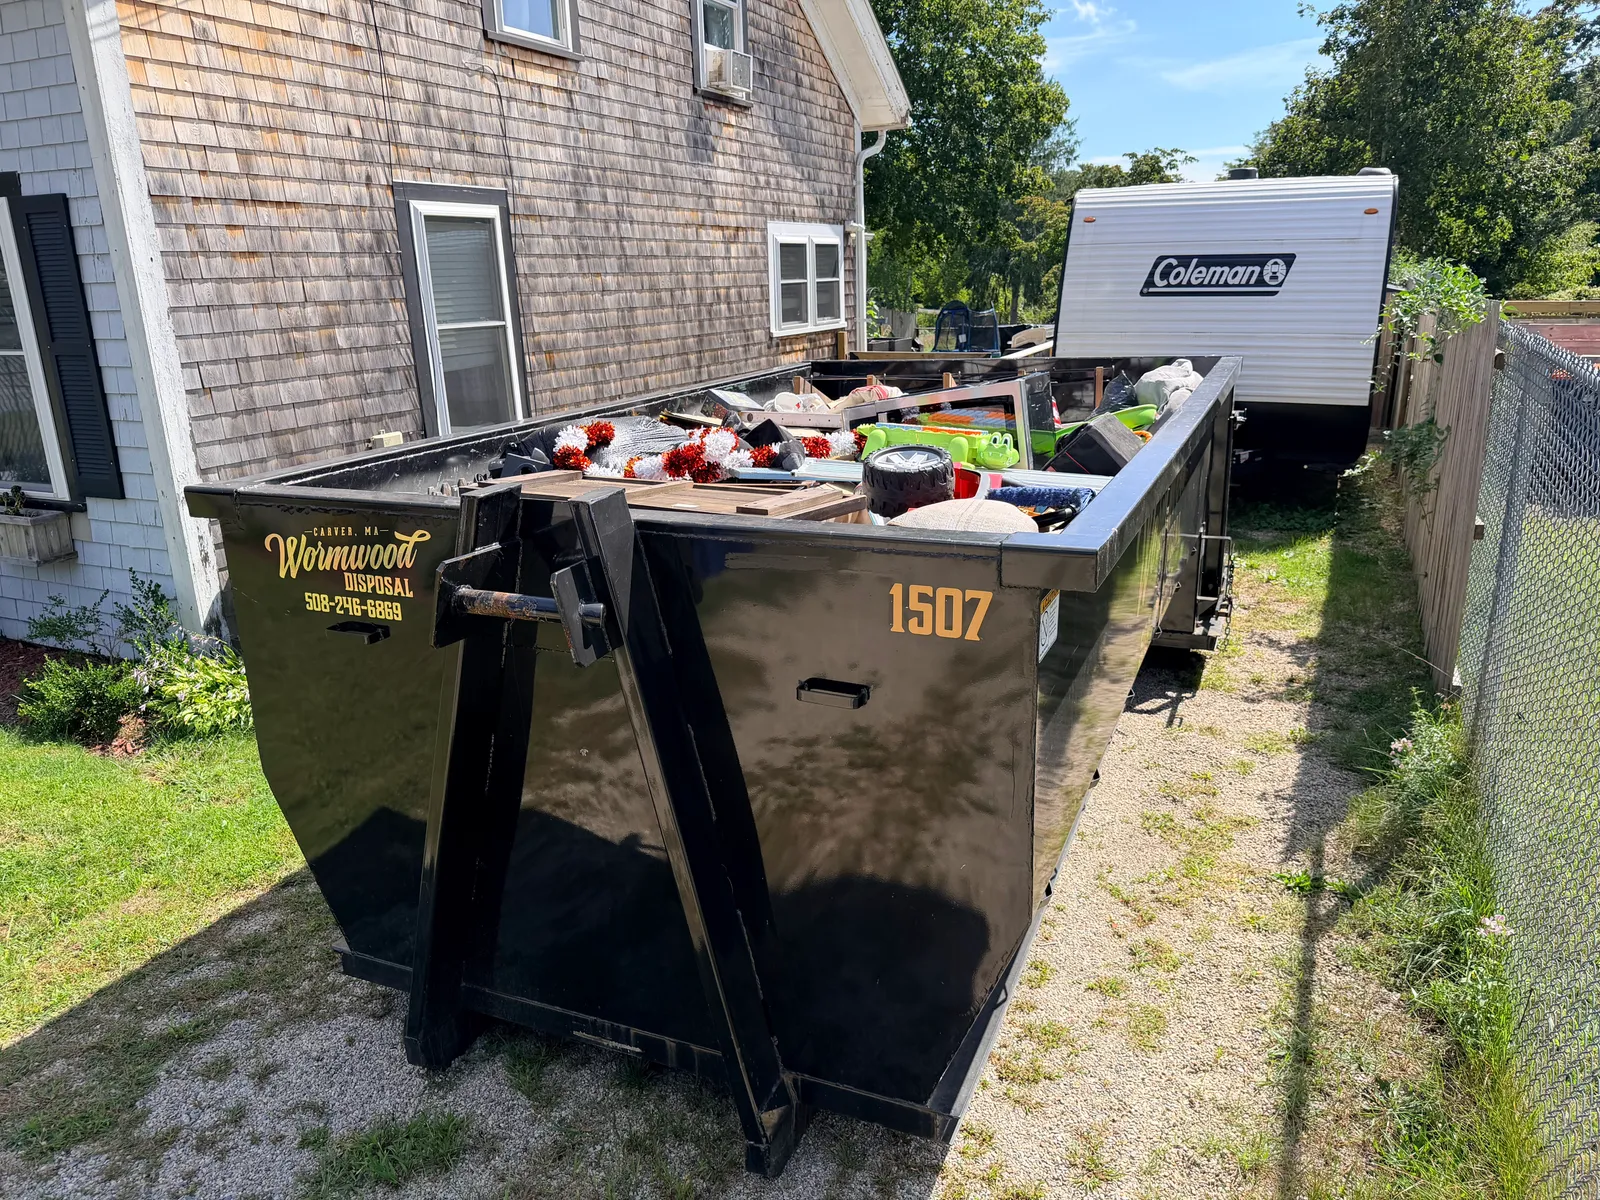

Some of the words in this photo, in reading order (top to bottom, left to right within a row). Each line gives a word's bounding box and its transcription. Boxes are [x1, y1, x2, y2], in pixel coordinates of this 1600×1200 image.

[1153, 258, 1261, 287] Coleman
[365, 526, 379, 536] MA
[264, 529, 432, 579] Wormwood
[344, 572, 414, 598] DISPOSAL
[304, 592, 403, 621] 508-246-6869
[889, 583, 993, 641] 1507
